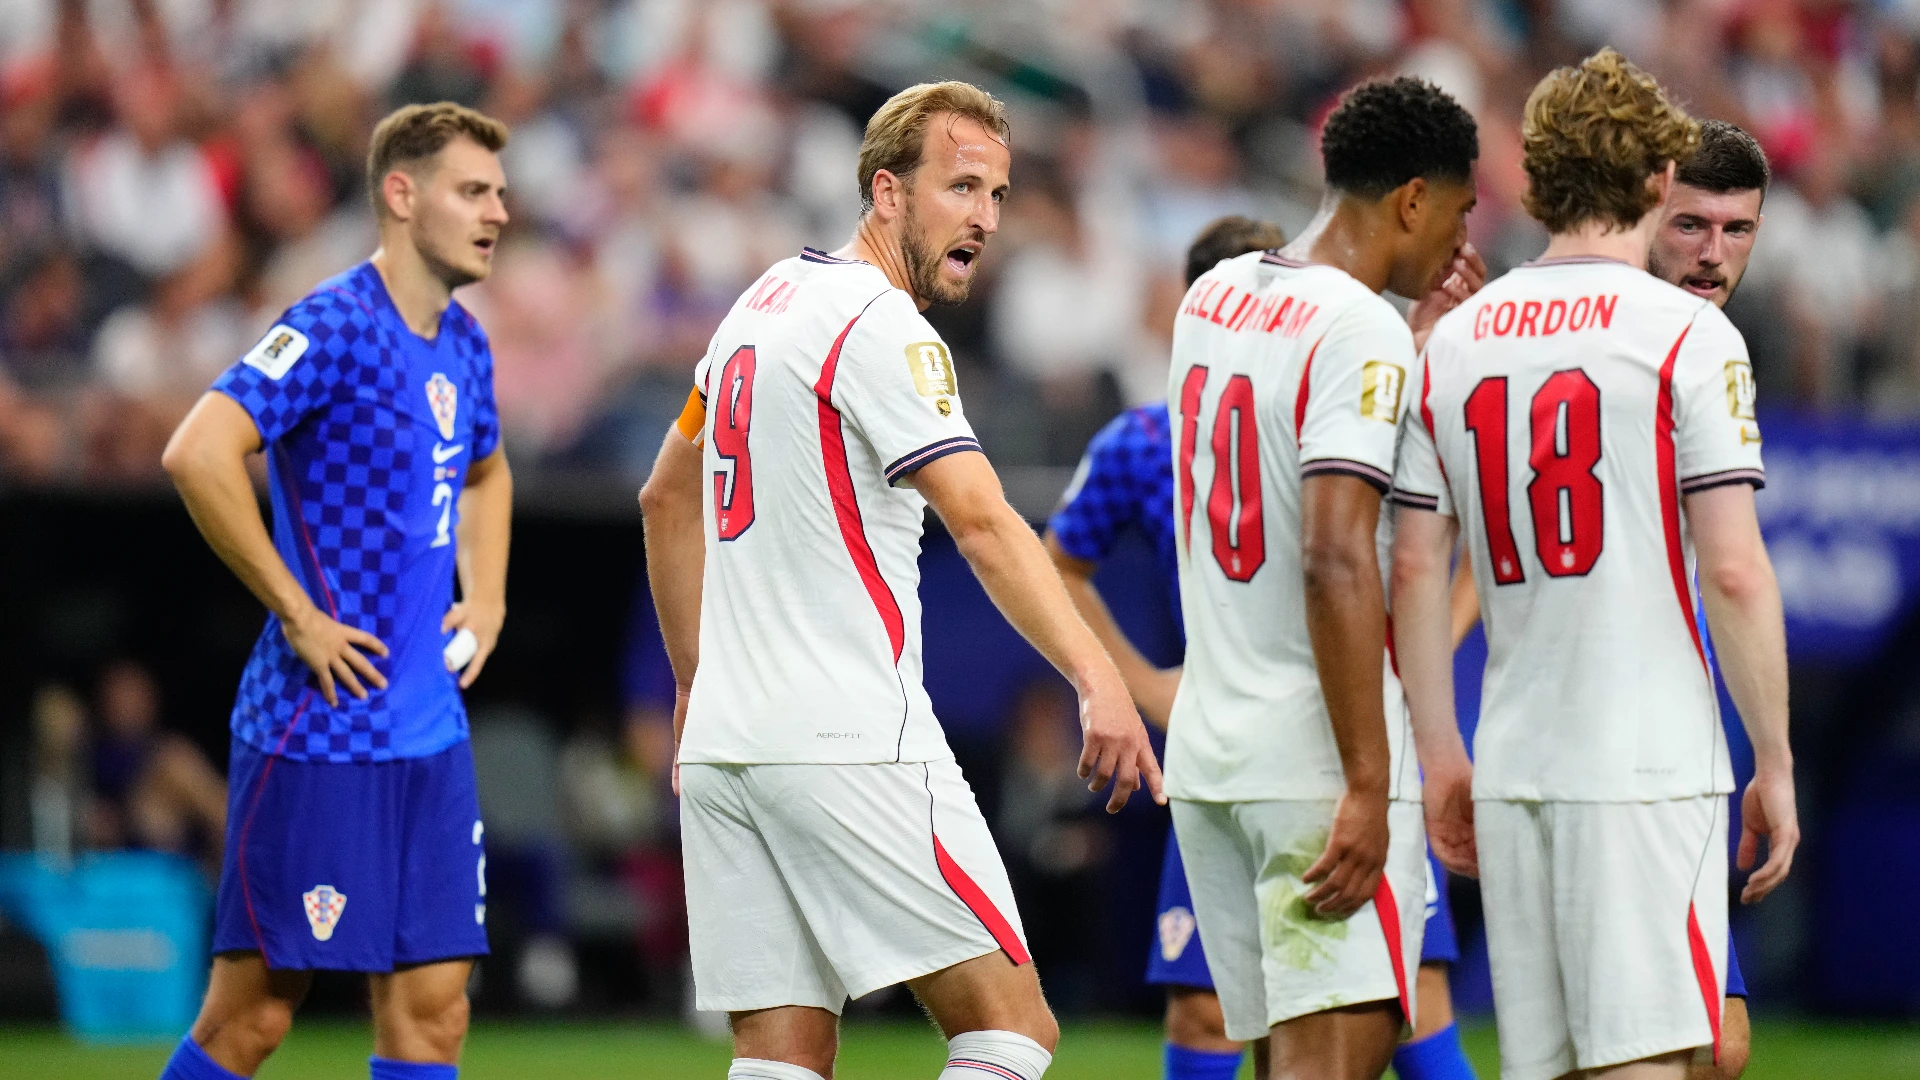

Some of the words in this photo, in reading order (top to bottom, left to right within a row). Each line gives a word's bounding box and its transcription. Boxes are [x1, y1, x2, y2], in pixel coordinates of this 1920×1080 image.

[1474, 294, 1619, 340] GORDON
[713, 344, 756, 542] 9
[1180, 364, 1266, 583] 10
[1463, 367, 1604, 586] 18
